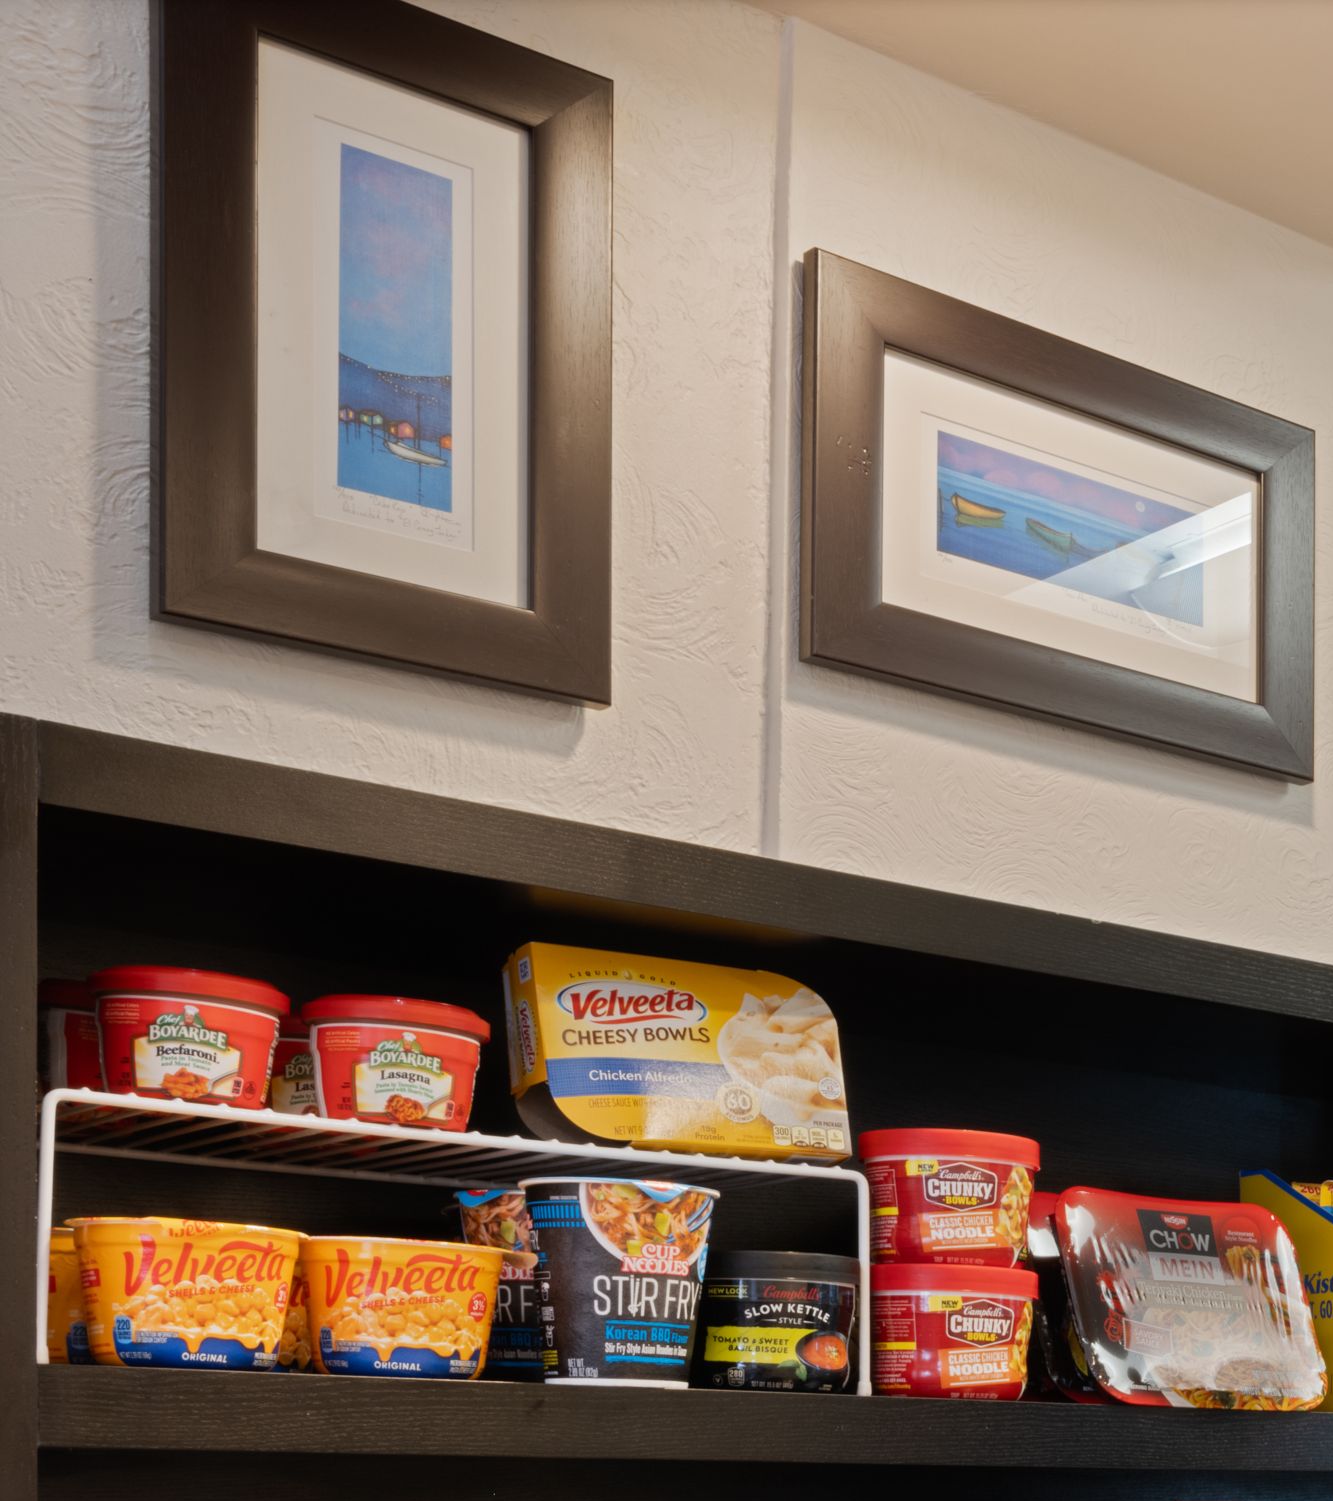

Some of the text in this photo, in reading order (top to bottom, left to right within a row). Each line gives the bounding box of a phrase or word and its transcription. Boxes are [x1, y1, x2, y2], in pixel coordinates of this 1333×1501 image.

[570, 989, 695, 1020] Velveeta
[157, 1013, 181, 1025] Chef
[150, 1024, 227, 1047] BOYARDEE
[562, 1027, 710, 1046] CHEESY BOWLS
[370, 1051, 441, 1072] BOYARDEE
[381, 1069, 430, 1085] Lasagna
[588, 1069, 692, 1084] Chicken Alfredo
[939, 1169, 982, 1181] Campbell's
[927, 1179, 993, 1199] CHUNKY
[945, 1196, 977, 1206] BOWLS
[930, 1226, 995, 1241] NOODLE
[1150, 1229, 1210, 1251] CHOW
[641, 1243, 680, 1260] CUP
[123, 1233, 286, 1296] Velveeta
[621, 1257, 690, 1276] NOODLES
[1160, 1258, 1214, 1279] MEIN
[325, 1248, 478, 1308] Velveeta
[744, 1303, 831, 1324] SLOW KETTLE
[778, 1317, 803, 1325] STYLE
[950, 1315, 1009, 1334] CHUNKY
[605, 1325, 688, 1343] Korean BBQ Flavor
[967, 1332, 996, 1342] BOWLS
[181, 1352, 227, 1364] ORIGINAL
[728, 1345, 789, 1354] BASIL BISQUE
[949, 1351, 1008, 1364] CLASSIC CHICKEN
[374, 1360, 421, 1371] ORIGINAL
[949, 1360, 1008, 1376] NOODLE
